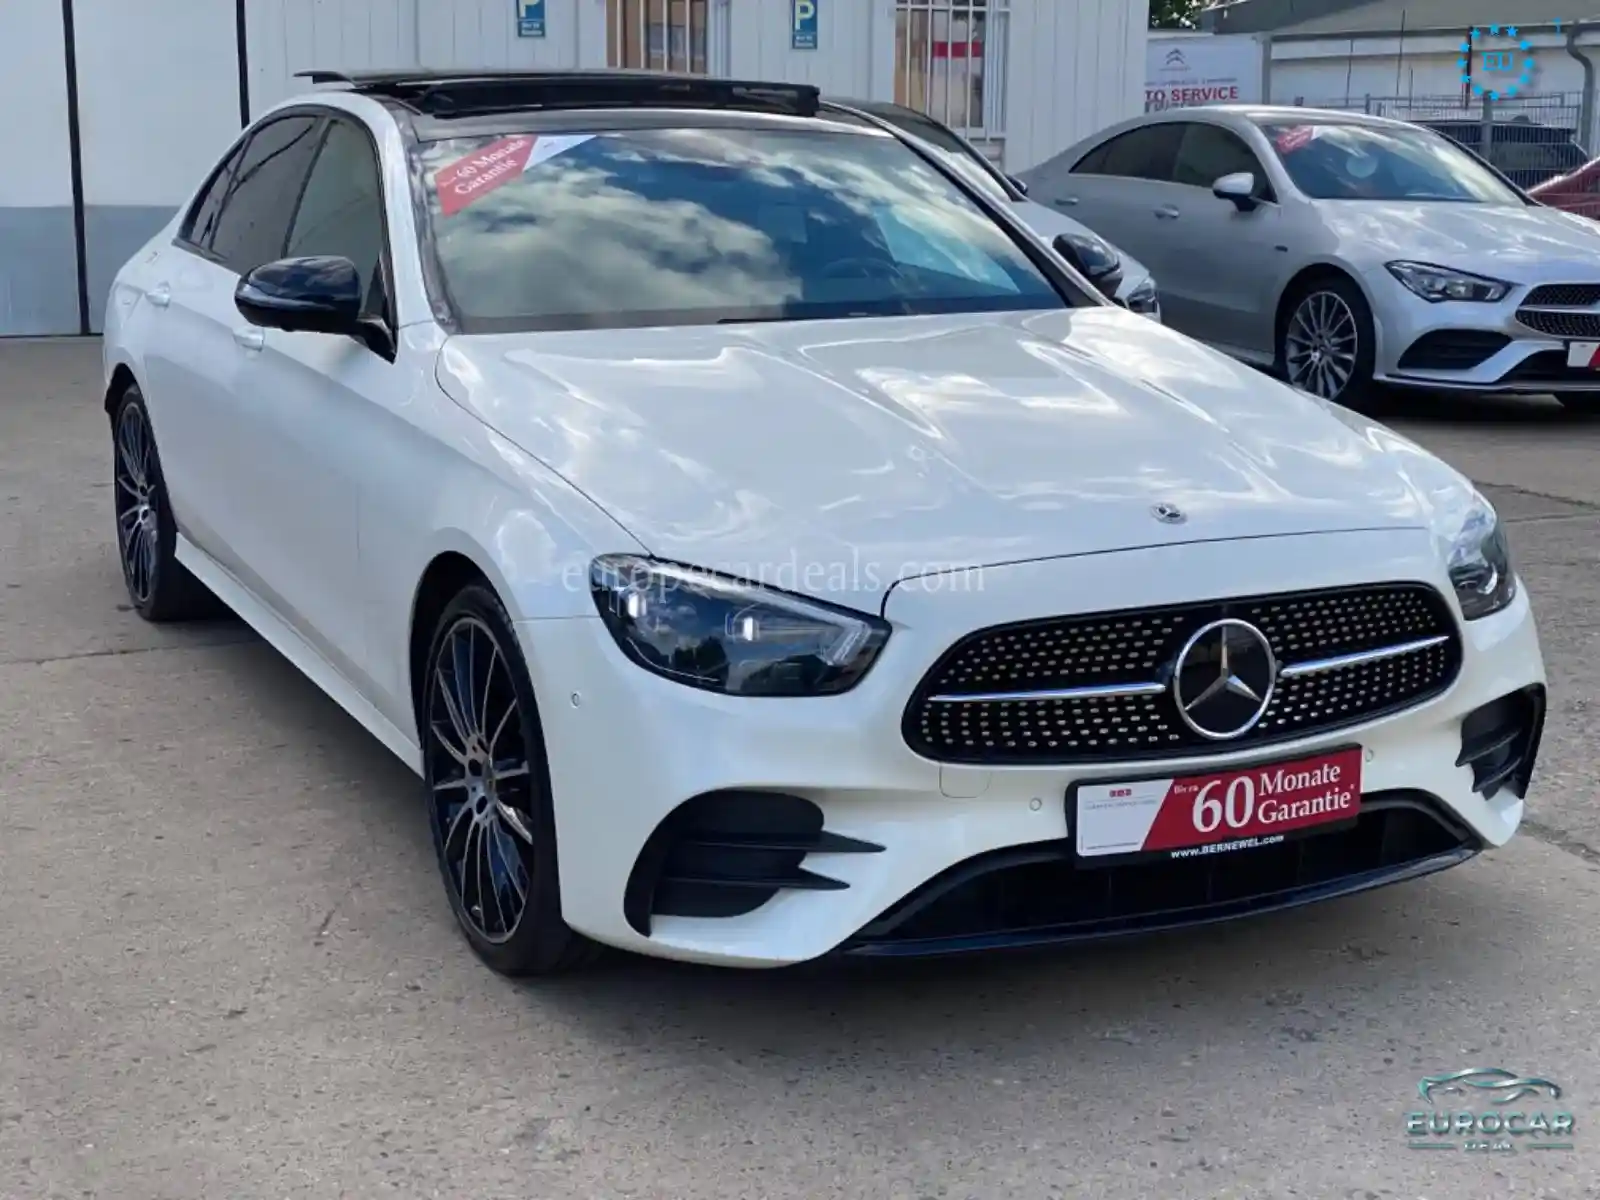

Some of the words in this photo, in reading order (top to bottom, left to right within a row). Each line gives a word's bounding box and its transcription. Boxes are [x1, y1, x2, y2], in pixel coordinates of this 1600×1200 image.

[795, 0, 815, 30] P
[1171, 86, 1239, 102] SERVICE
[1192, 775, 1255, 833] 60
[1258, 763, 1341, 797] Monate
[1171, 834, 1285, 859] www.BERNEWEL.com
